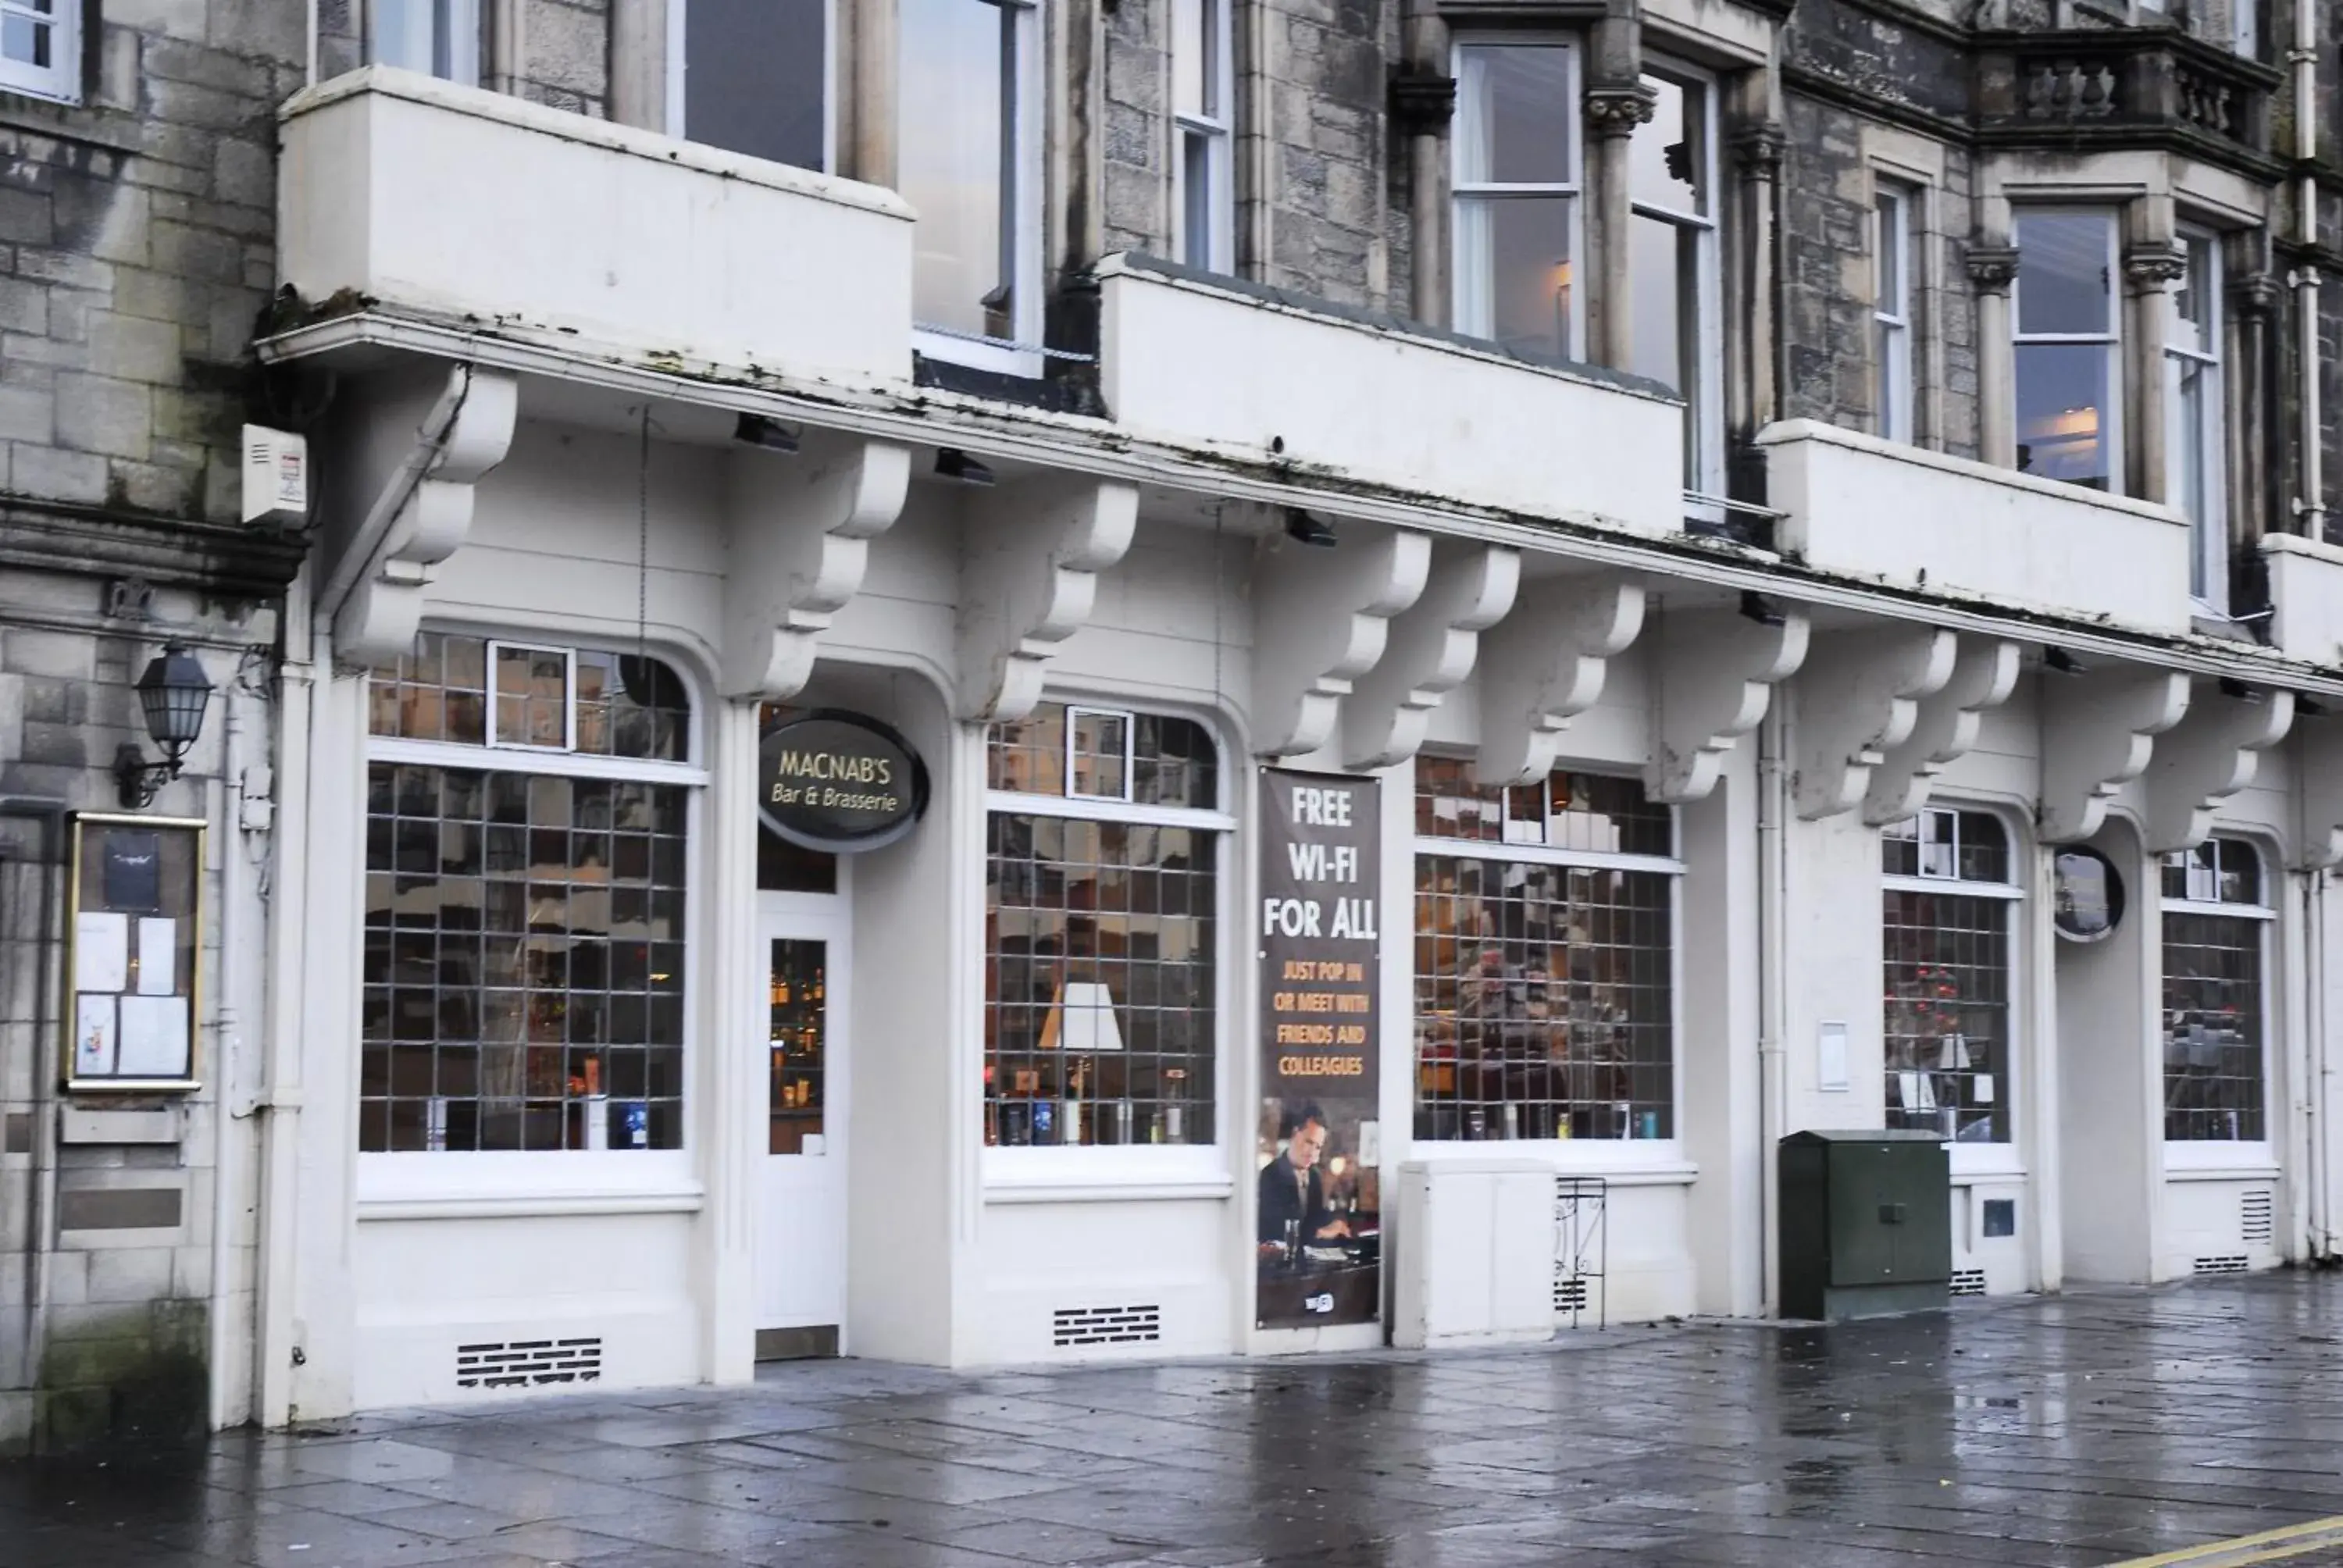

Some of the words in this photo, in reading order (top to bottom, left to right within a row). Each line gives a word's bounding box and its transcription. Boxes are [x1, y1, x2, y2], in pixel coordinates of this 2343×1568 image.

[779, 750, 891, 785] MACNAB'S
[772, 783, 801, 803] Bar
[805, 786, 819, 806] &
[822, 787, 898, 811] Brasserie
[1292, 786, 1352, 827] FREE
[1288, 843, 1357, 883] WI-FI
[1264, 898, 1321, 938] FOR
[1330, 897, 1378, 939] ALL
[1282, 960, 1316, 981] JUST
[1318, 961, 1343, 982] POP
[1274, 992, 1294, 1011] OR
[1297, 992, 1335, 1012] MEET
[1336, 994, 1369, 1012] WITH
[1277, 1025, 1333, 1044] FRIENDS
[1336, 1025, 1365, 1044] AND
